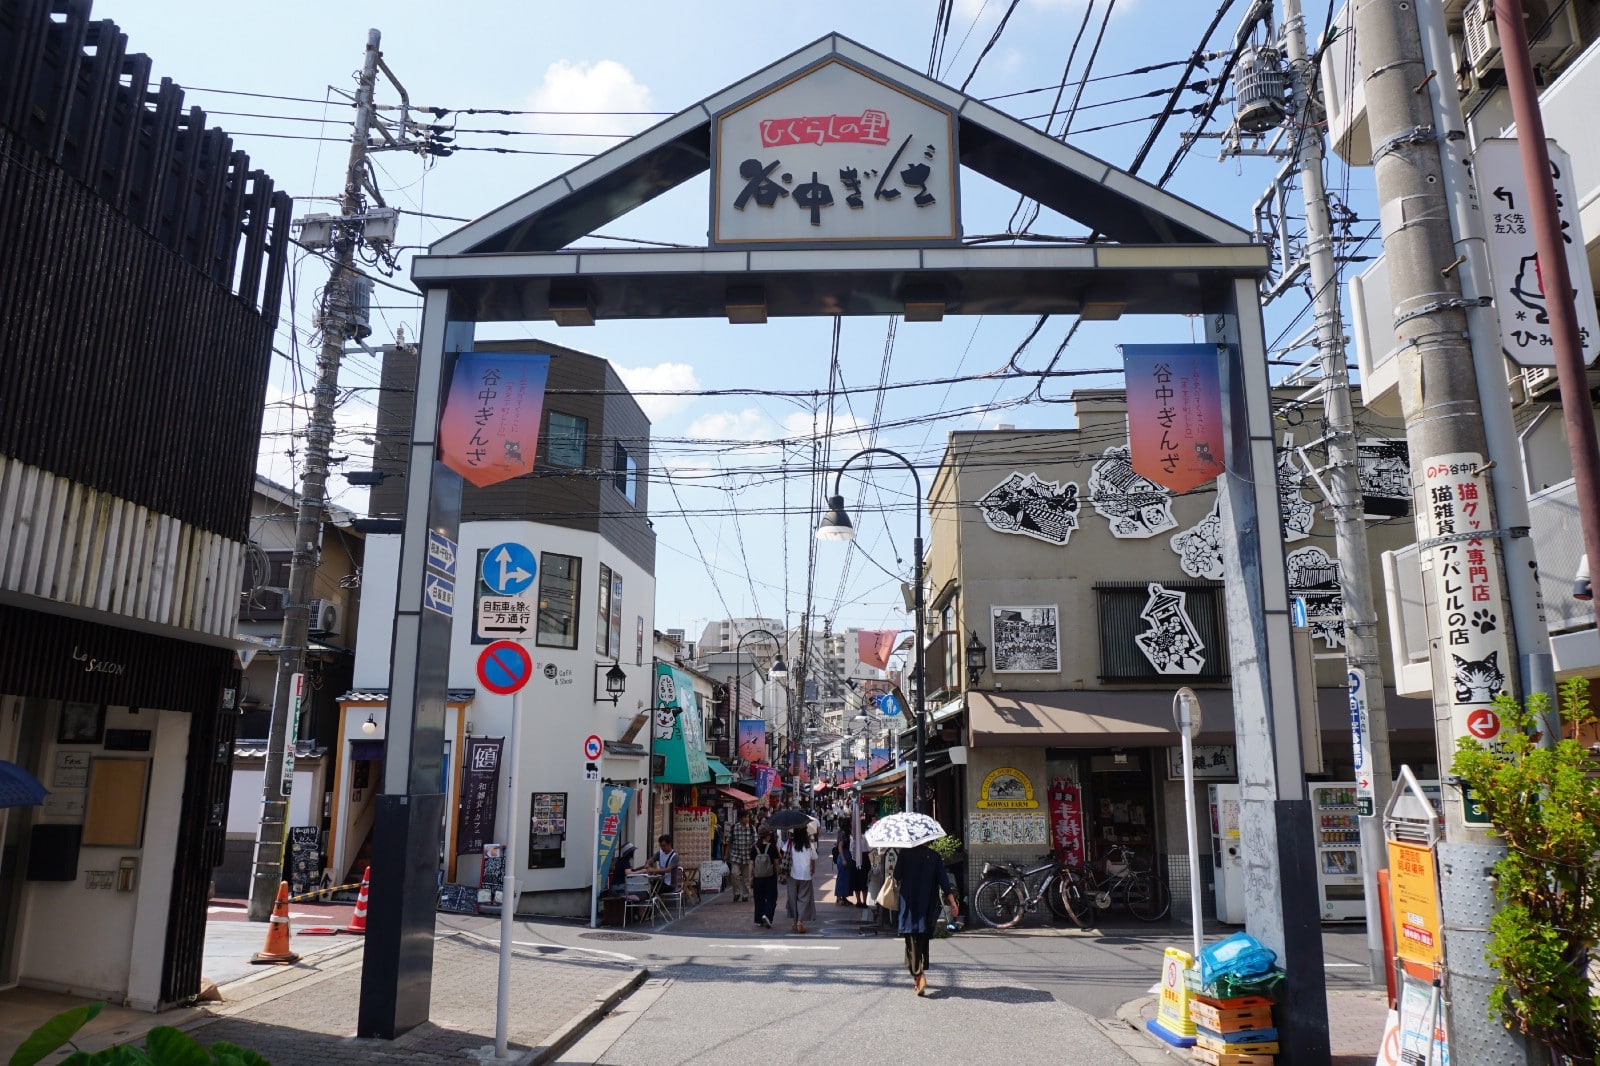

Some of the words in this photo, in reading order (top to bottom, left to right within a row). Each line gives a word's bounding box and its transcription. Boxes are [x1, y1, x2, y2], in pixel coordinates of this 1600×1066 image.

[763, 110, 889, 146] ひぐらしの里
[734, 134, 936, 226] 谷中ぎんざ
[1493, 213, 1525, 223] すぐ先
[1494, 224, 1526, 234] 左入る
[1510, 327, 1590, 348] ひみ堂
[466, 368, 501, 466] 谷中ぎんざ
[1153, 363, 1180, 474] 谷中ぎんざ
[483, 601, 530, 612] 自転車を除く
[483, 613, 530, 624] 一方通行
